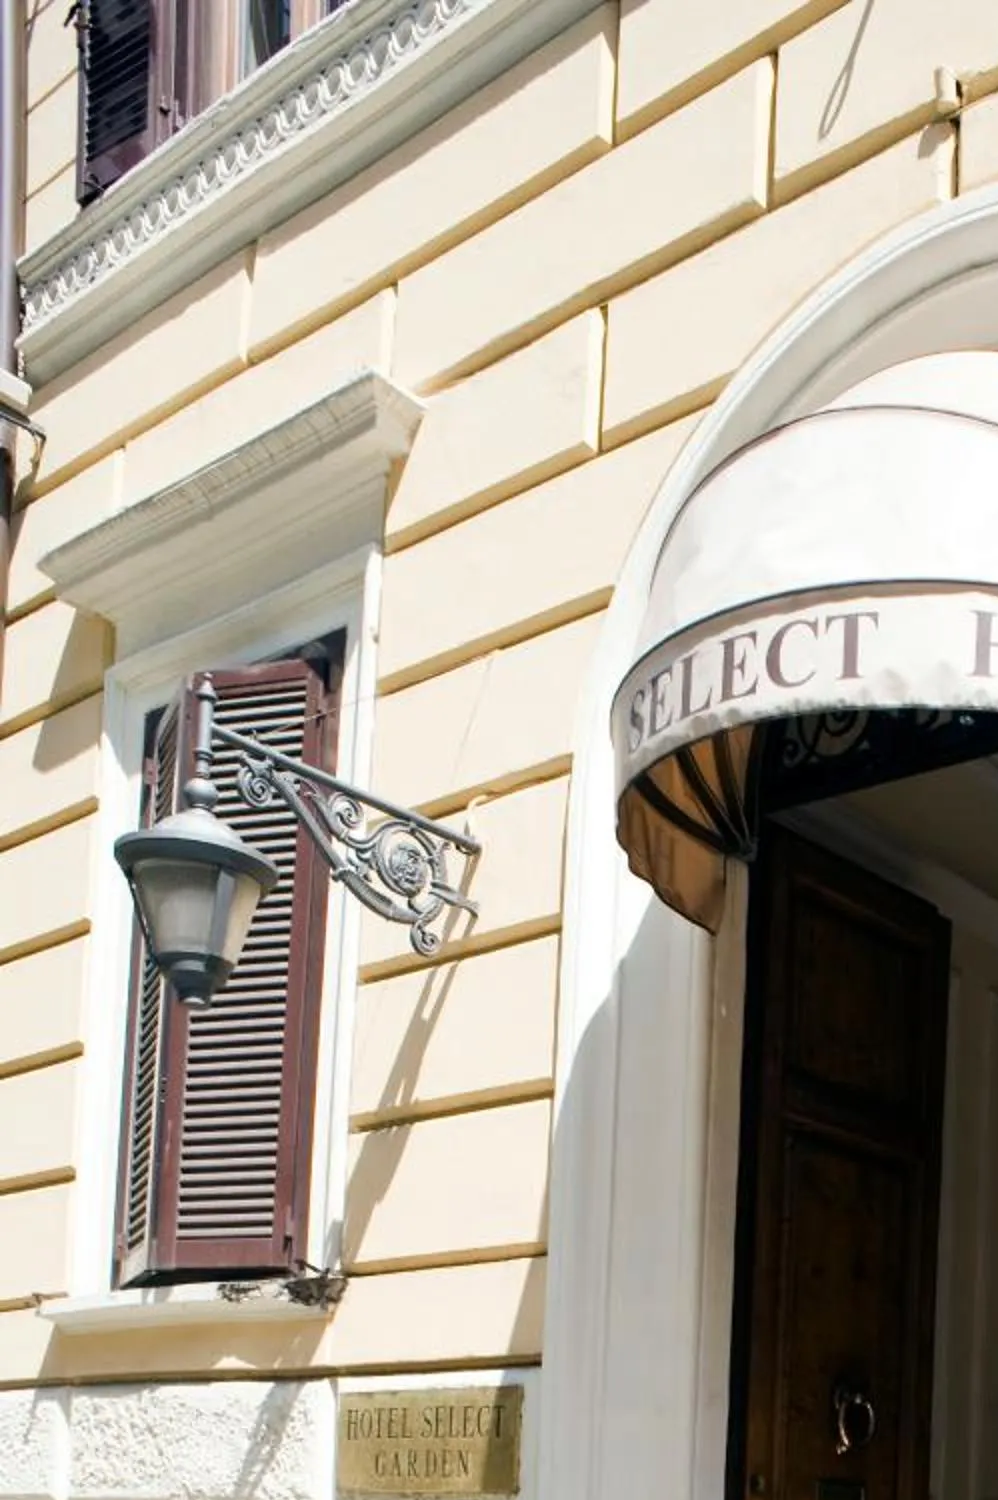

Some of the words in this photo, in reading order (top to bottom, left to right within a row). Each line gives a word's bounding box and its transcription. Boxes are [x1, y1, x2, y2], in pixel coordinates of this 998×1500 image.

[627, 611, 879, 752] SELECT
[347, 1407, 412, 1440] HOTEL
[420, 1405, 506, 1438] SELECT
[374, 1449, 471, 1478] GARDEN
